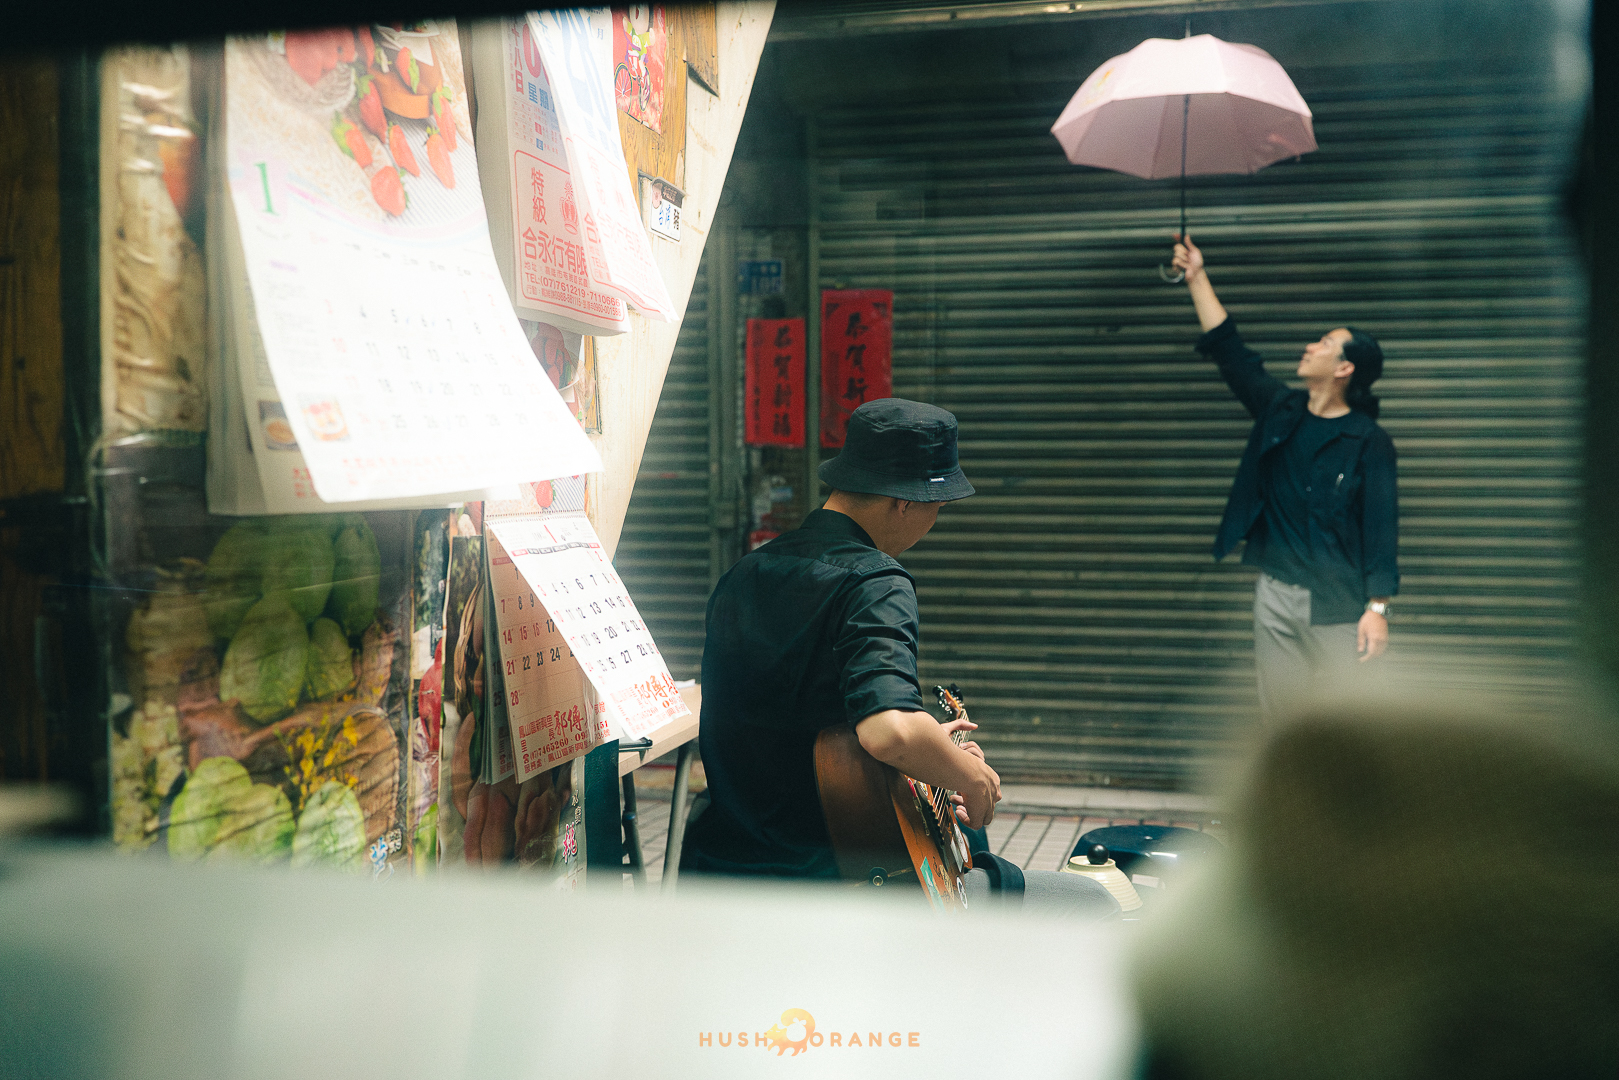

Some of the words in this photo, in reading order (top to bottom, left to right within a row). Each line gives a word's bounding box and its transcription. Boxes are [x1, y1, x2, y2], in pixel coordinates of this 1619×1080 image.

[531, 166, 548, 225] 特級
[502, 629, 513, 645] 14
[519, 625, 528, 640] 15
[506, 659, 516, 676] 21
[522, 655, 531, 671] 22
[536, 651, 544, 666] 23
[550, 646, 561, 662] 24
[510, 690, 520, 707] 28
